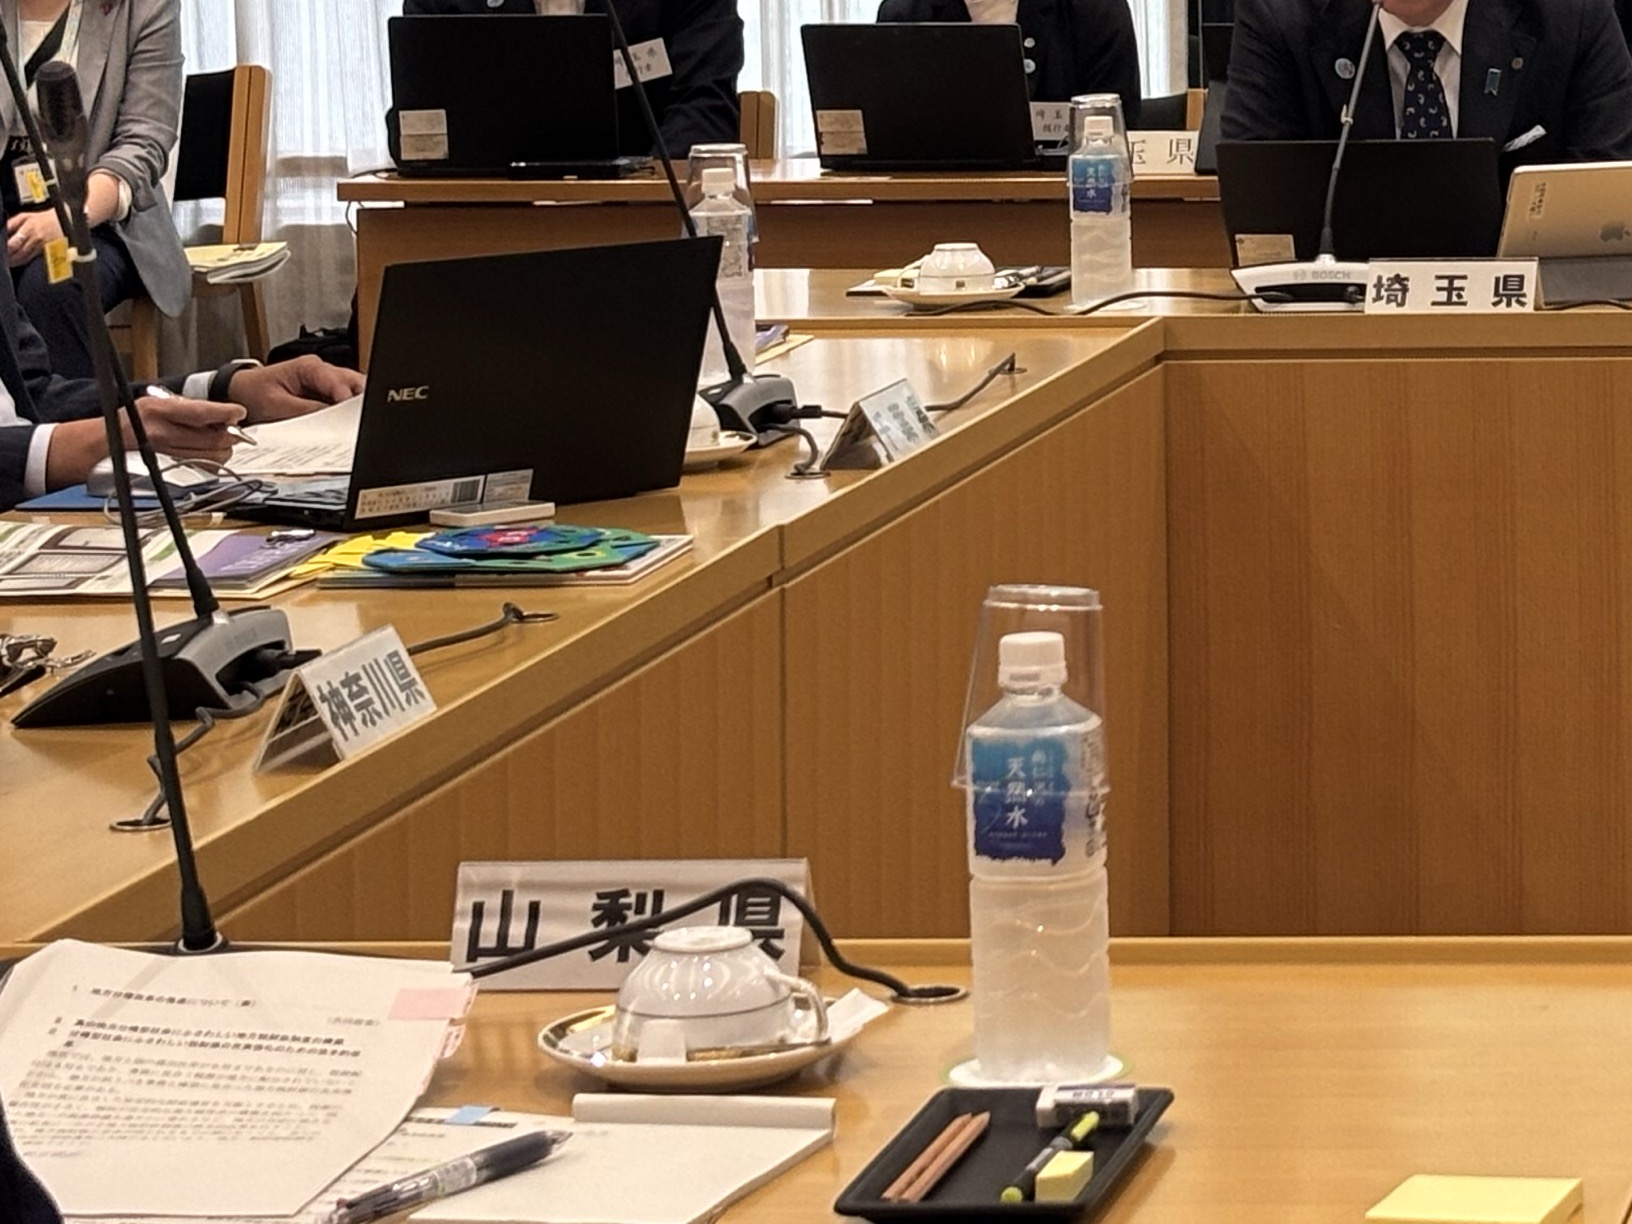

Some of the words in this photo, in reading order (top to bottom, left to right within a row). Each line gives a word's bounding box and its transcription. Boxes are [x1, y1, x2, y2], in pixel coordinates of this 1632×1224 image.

[1372, 273, 1528, 308] 埼玉県
[387, 385, 430, 403] NEC
[316, 649, 427, 742] 神奈川県
[1005, 756, 1029, 830] 天然水
